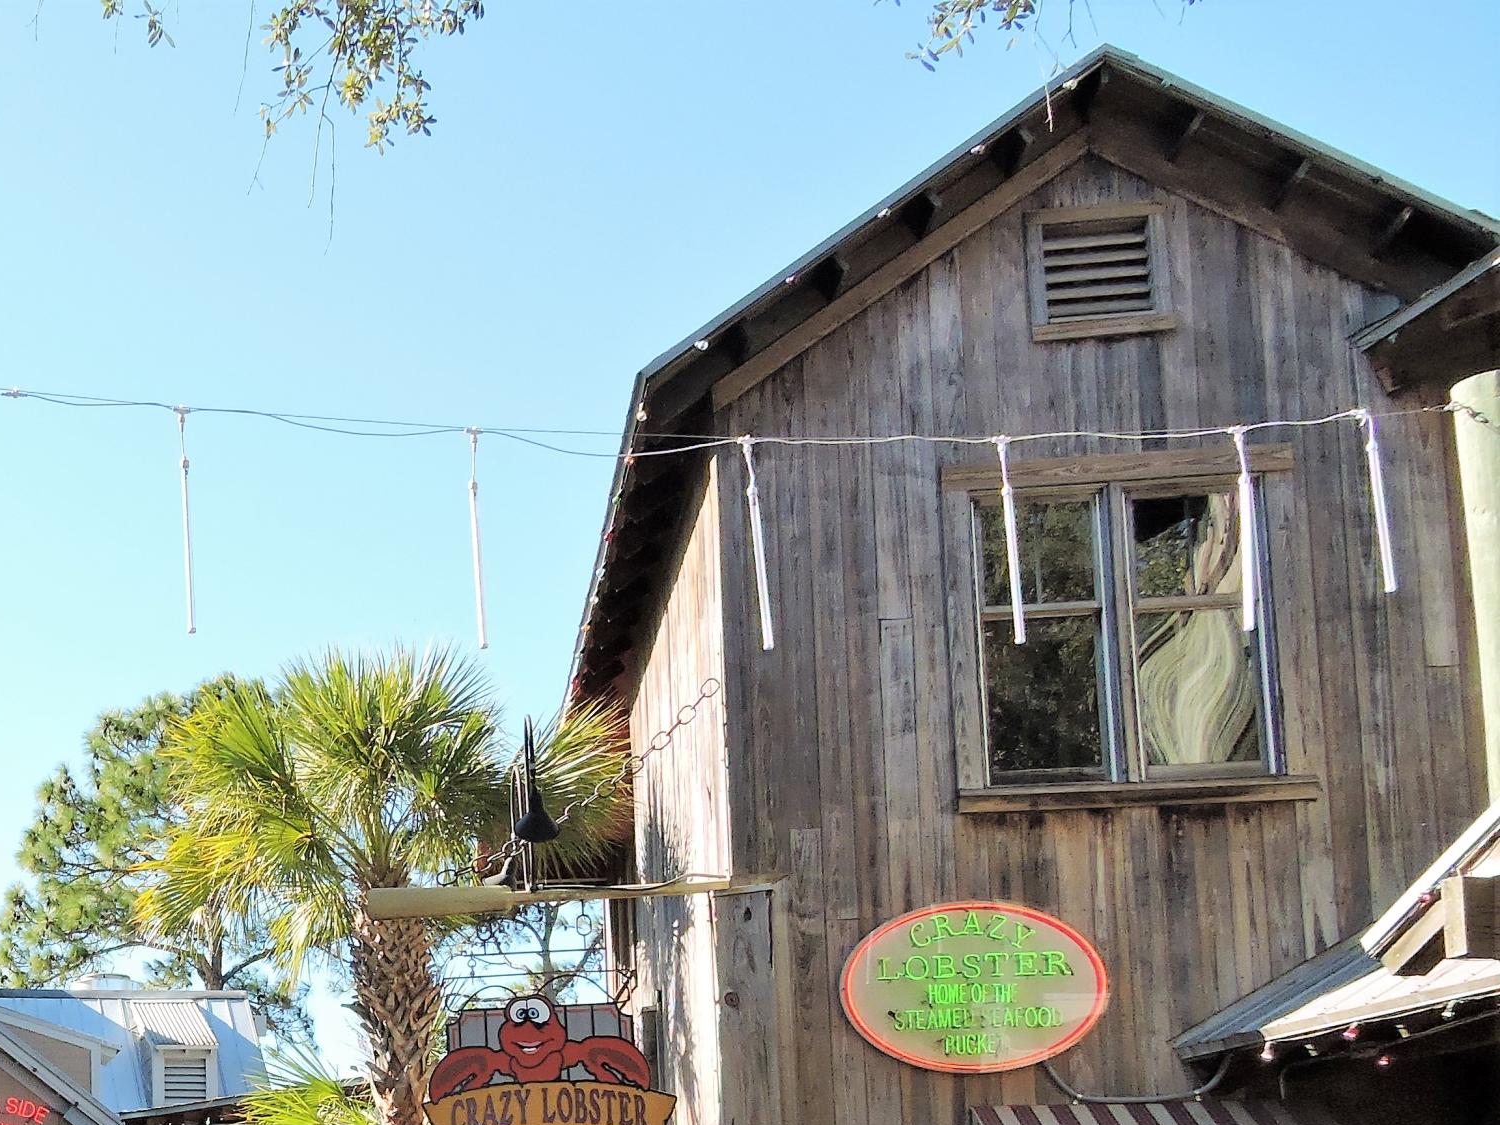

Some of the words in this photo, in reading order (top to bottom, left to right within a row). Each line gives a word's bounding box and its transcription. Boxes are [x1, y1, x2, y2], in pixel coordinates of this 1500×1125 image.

[910, 911, 1036, 948] CRAZY
[876, 951, 1073, 981] LOBSTER
[928, 984, 967, 1003] HOME
[971, 983, 986, 1003] OF
[992, 983, 1018, 1003] THE
[893, 1008, 974, 1030] STEAMED
[945, 1034, 1010, 1055] BUCKE
[5, 1097, 50, 1125] SIDE
